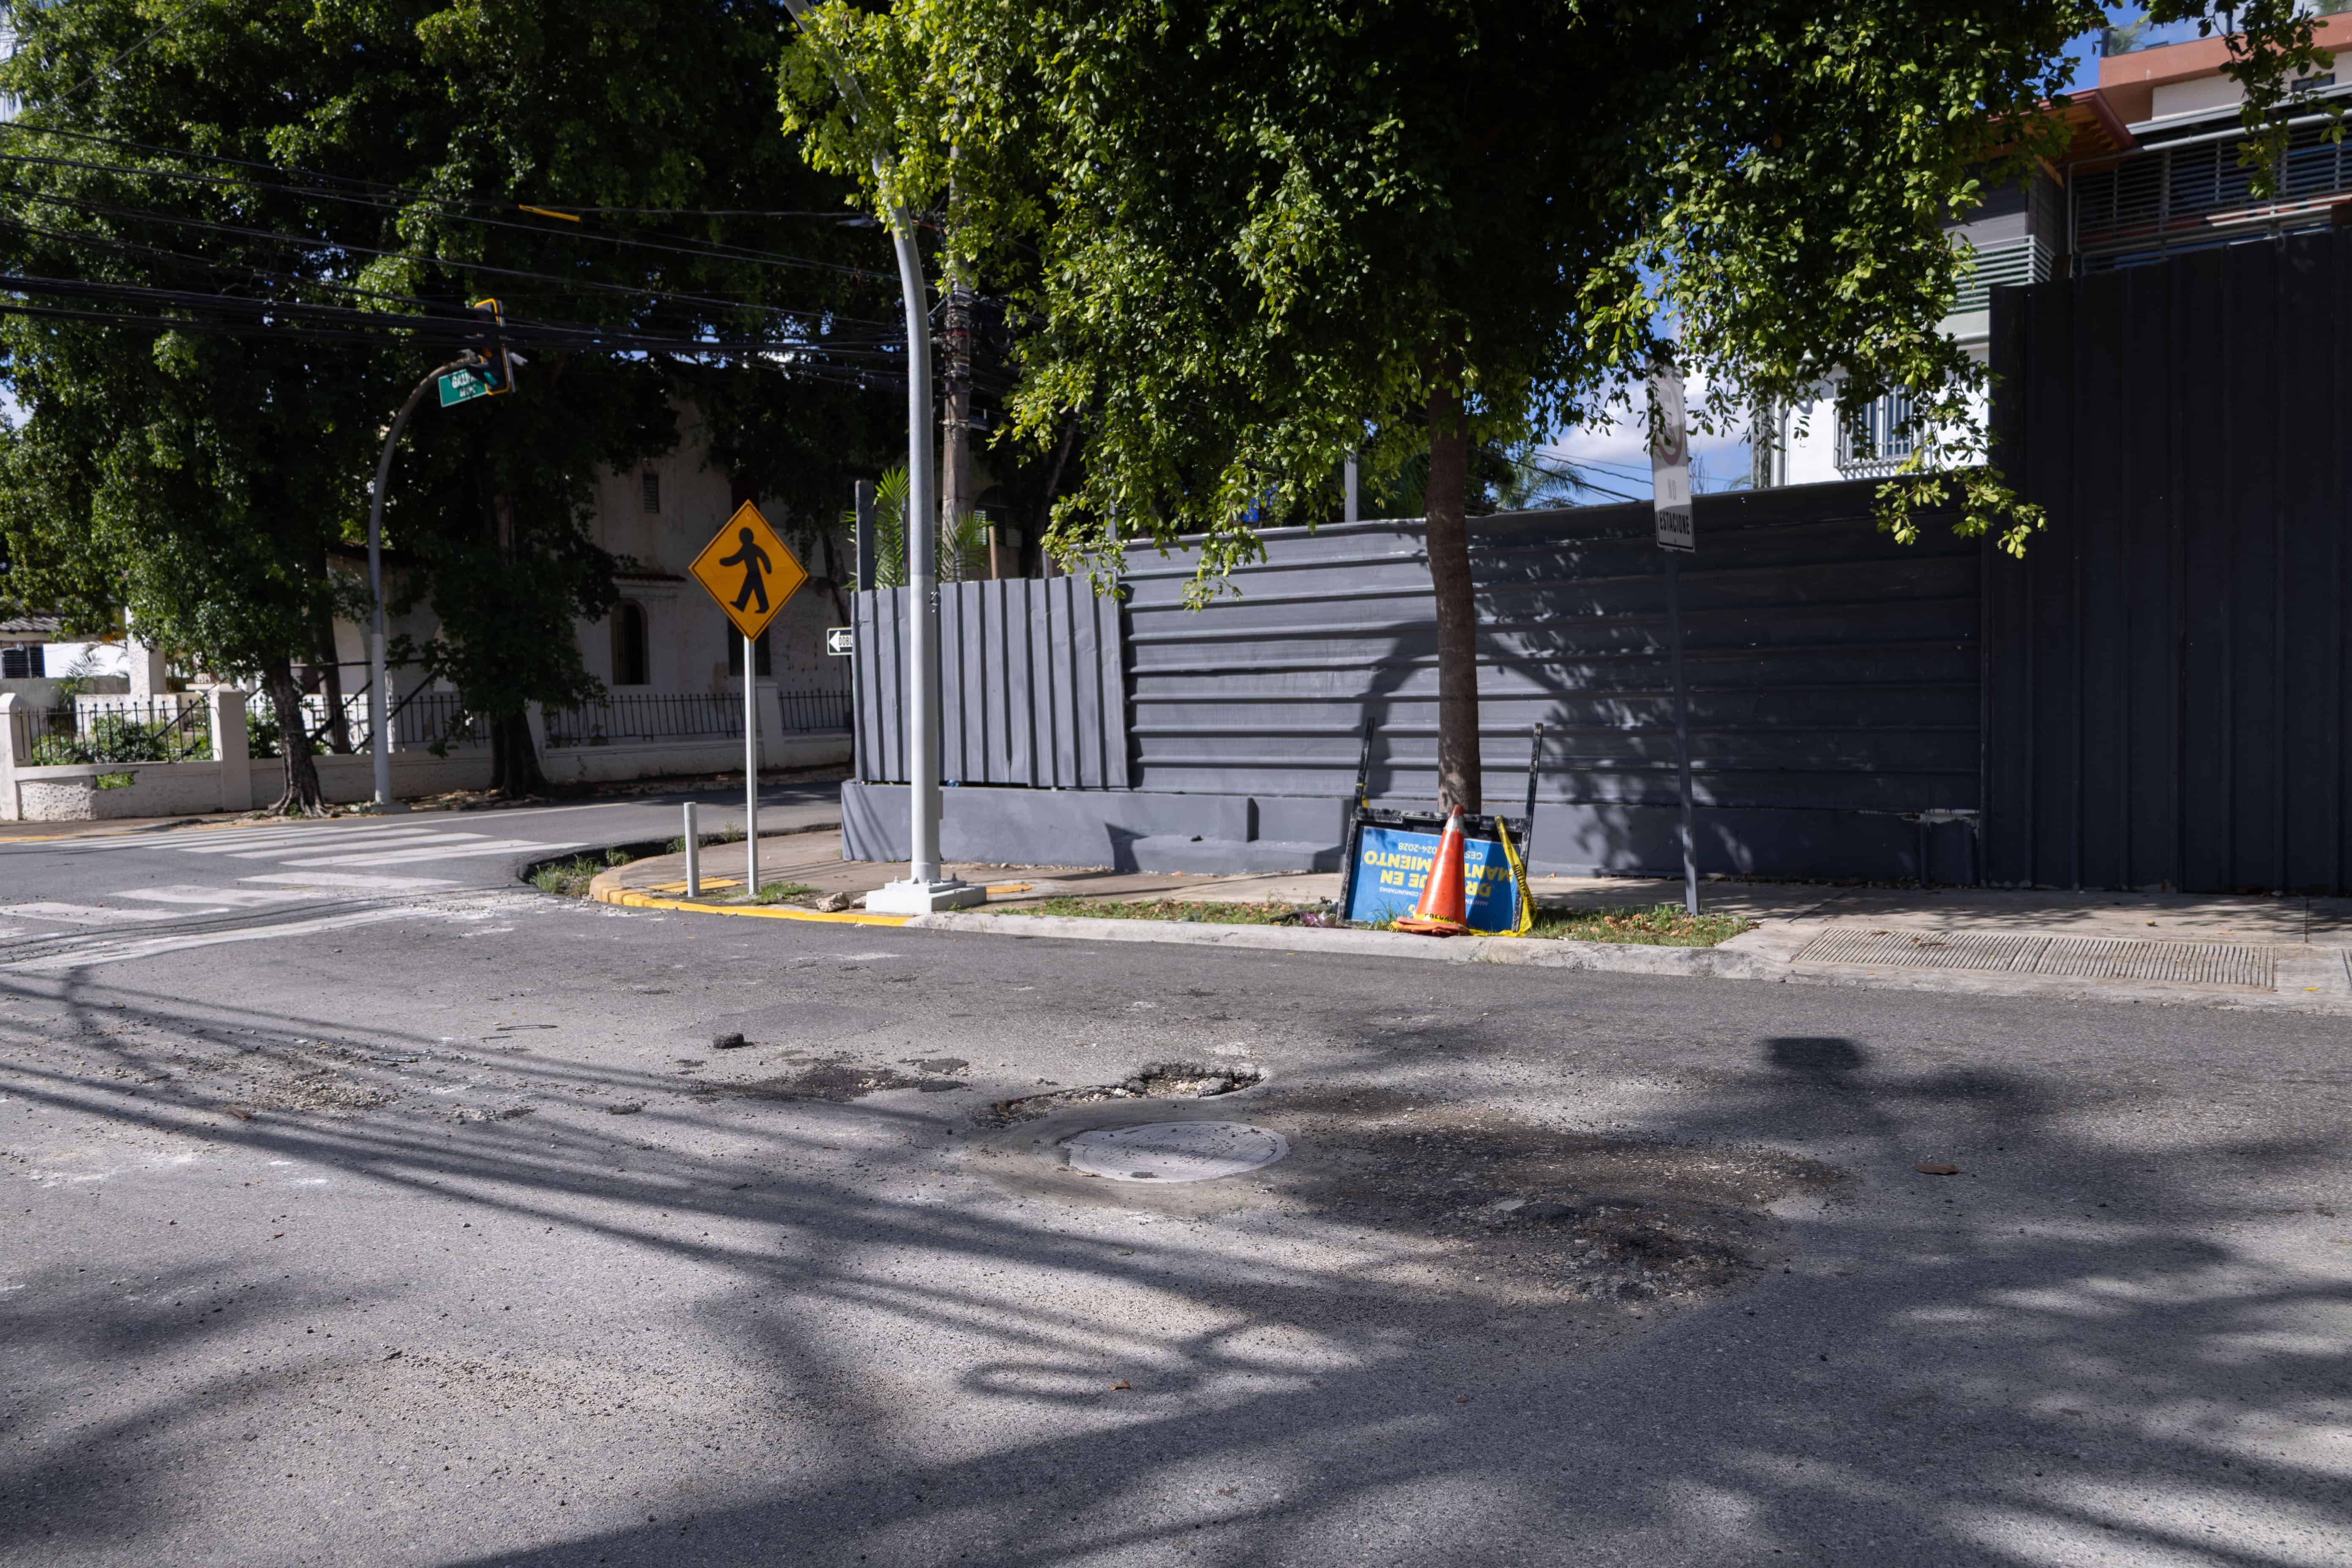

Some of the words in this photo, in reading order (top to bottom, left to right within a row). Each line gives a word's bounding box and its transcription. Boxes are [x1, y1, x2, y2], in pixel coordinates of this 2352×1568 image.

[1659, 510, 1690, 535] ESTACIONE
[839, 636, 852, 646] DOBL
[1398, 842, 1437, 854] 024-2028
[1364, 850, 1514, 883] MANTMIENTO
[1380, 870, 1404, 886] EN
[1379, 887, 1419, 897] COMUNITARIAS
